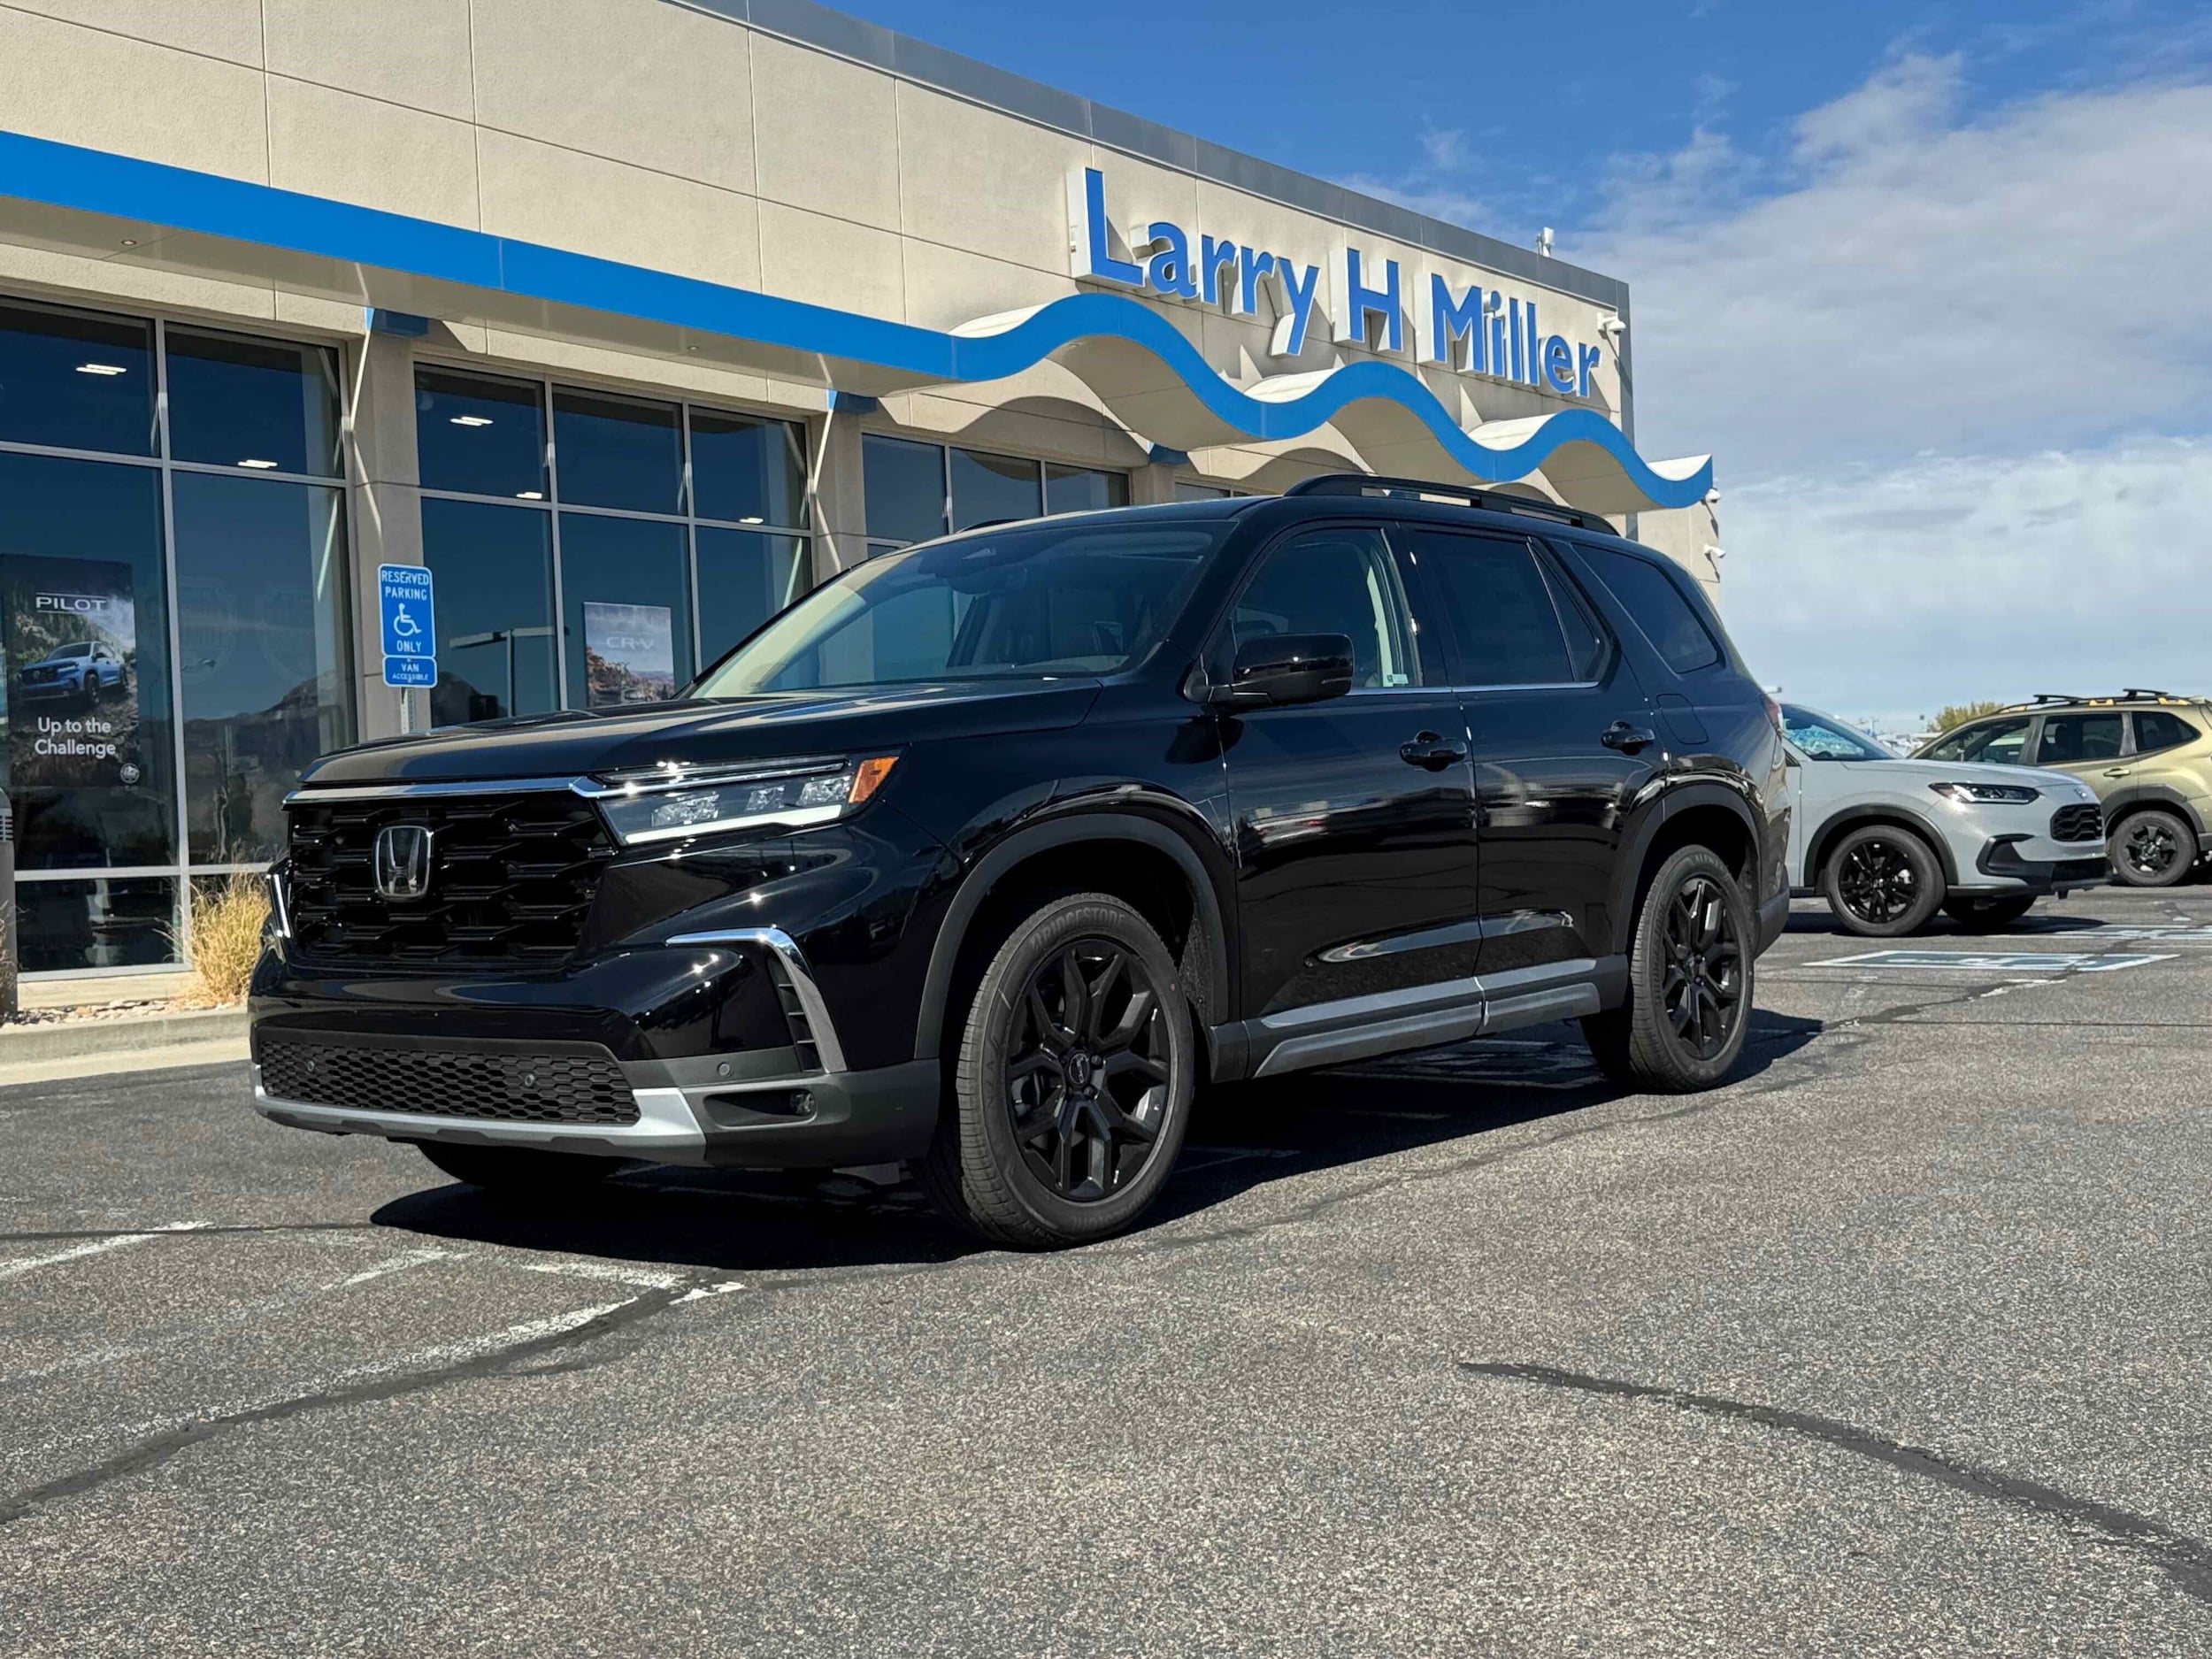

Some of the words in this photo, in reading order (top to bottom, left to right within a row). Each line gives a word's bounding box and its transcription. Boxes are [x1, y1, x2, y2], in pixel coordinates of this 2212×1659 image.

[1083, 165, 1320, 357] Larry
[1345, 246, 1403, 352] H
[1429, 271, 1601, 398] Miller
[381, 569, 430, 586] RESERVED
[385, 586, 427, 602] PARKING
[35, 596, 106, 612] PILOT
[396, 640, 422, 653] ONLY
[606, 636, 655, 649] CR-V
[401, 663, 419, 672] VAN
[37, 717, 62, 736] Up
[65, 718, 82, 733] to
[86, 718, 111, 733] the
[35, 739, 116, 759] Challenge
